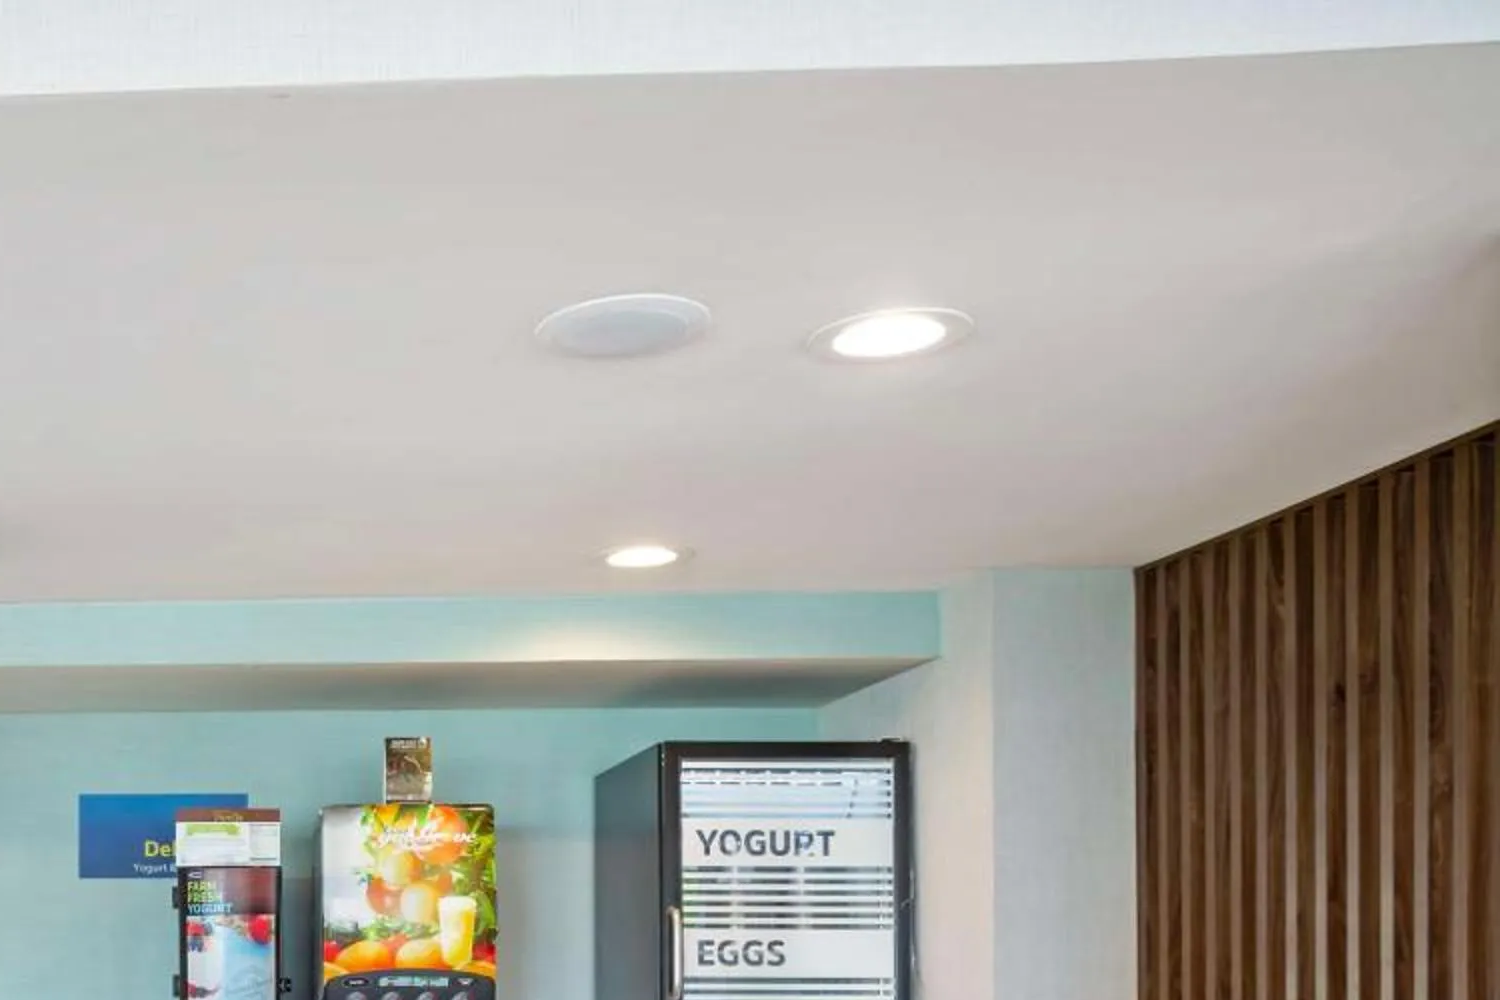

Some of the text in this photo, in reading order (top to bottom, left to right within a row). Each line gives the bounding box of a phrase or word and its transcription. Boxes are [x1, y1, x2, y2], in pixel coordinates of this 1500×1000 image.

[695, 828, 836, 857] YOGURT
[133, 863, 168, 876] Yogurt
[187, 903, 232, 914] YOGURT
[696, 938, 786, 967] EGGS
